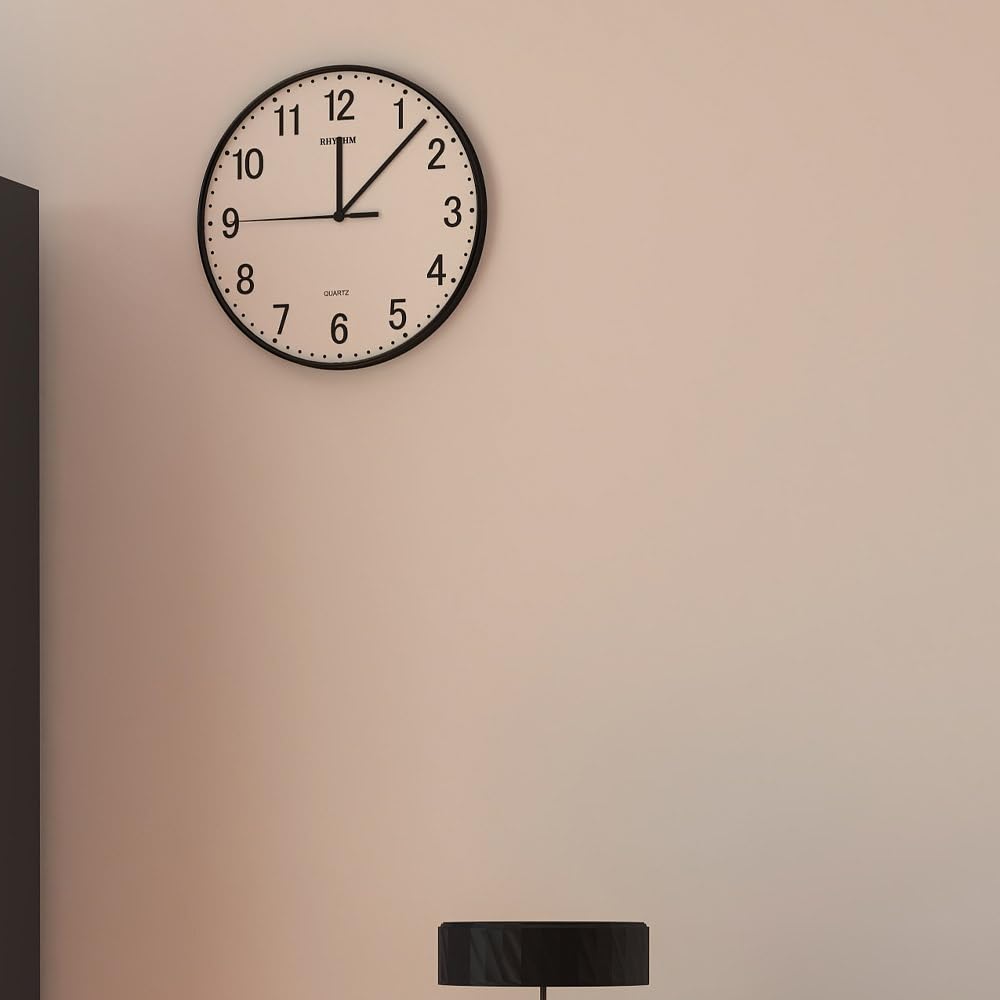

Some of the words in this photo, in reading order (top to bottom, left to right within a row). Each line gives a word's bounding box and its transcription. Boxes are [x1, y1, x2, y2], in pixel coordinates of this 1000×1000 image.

[274, 103, 299, 137] 11
[324, 89, 355, 121] 12
[393, 97, 404, 129] 1
[319, 137, 356, 145] RHYHM
[427, 138, 446, 170] 2
[232, 148, 264, 180] 10
[222, 207, 239, 239] 9
[444, 196, 462, 228] 3
[236, 263, 254, 295] 8
[426, 254, 446, 286] 4
[323, 289, 349, 297] QUARTZ
[273, 304, 290, 335] 7
[330, 313, 348, 344] 6
[388, 298, 407, 330] 5
